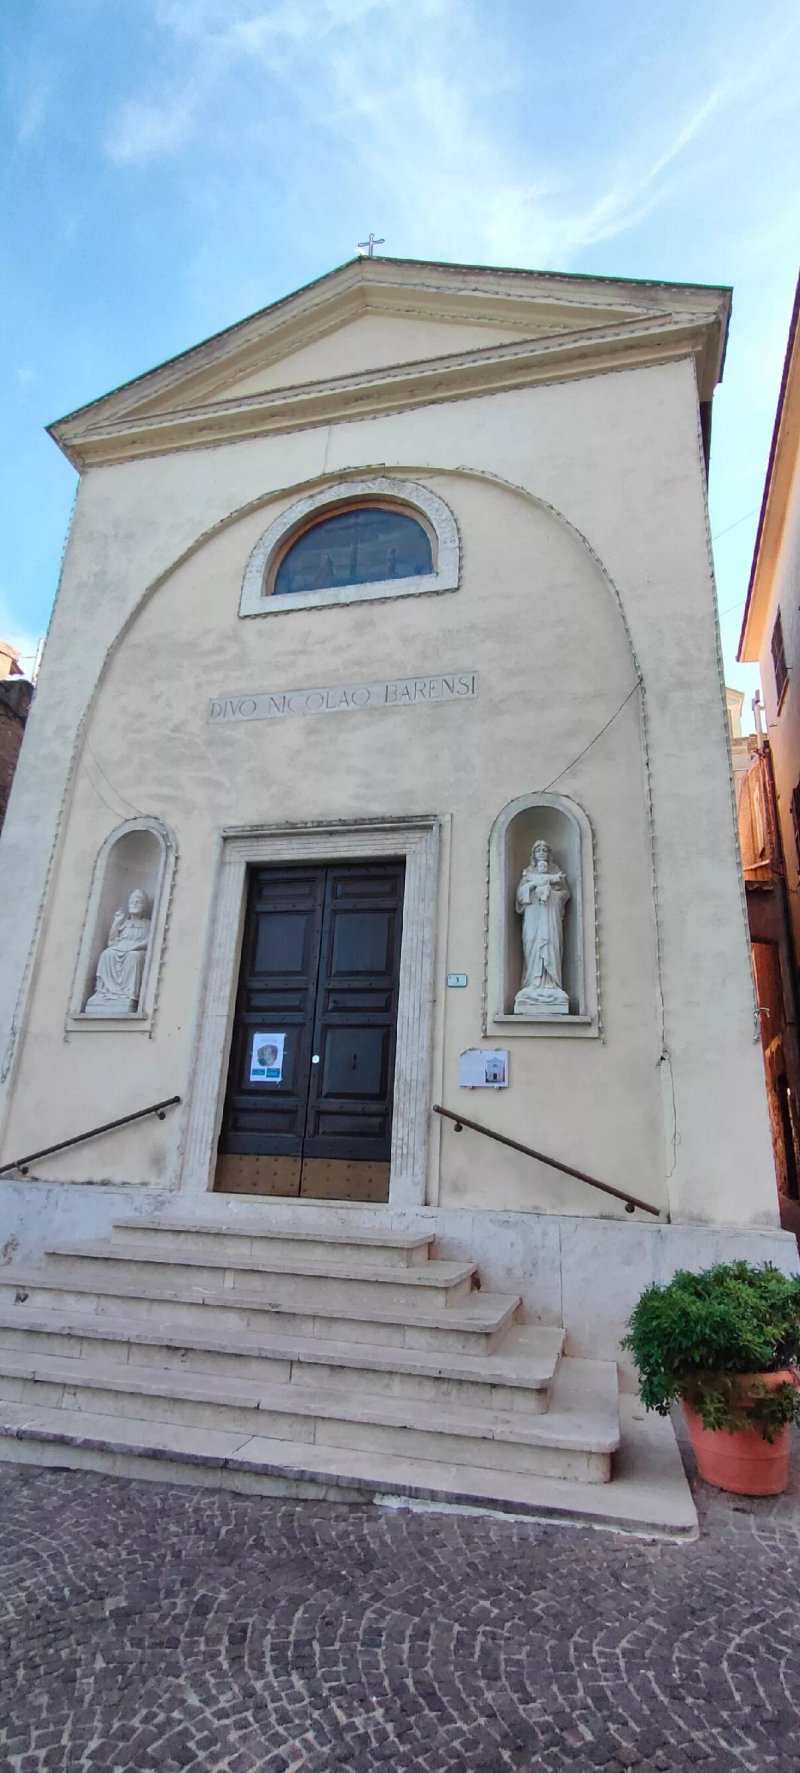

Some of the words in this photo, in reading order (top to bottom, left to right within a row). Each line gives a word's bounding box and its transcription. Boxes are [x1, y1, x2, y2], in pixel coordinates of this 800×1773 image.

[210, 698, 257, 719] DIVO
[268, 688, 371, 713] NICOLAO
[384, 675, 476, 703] BARENSI
